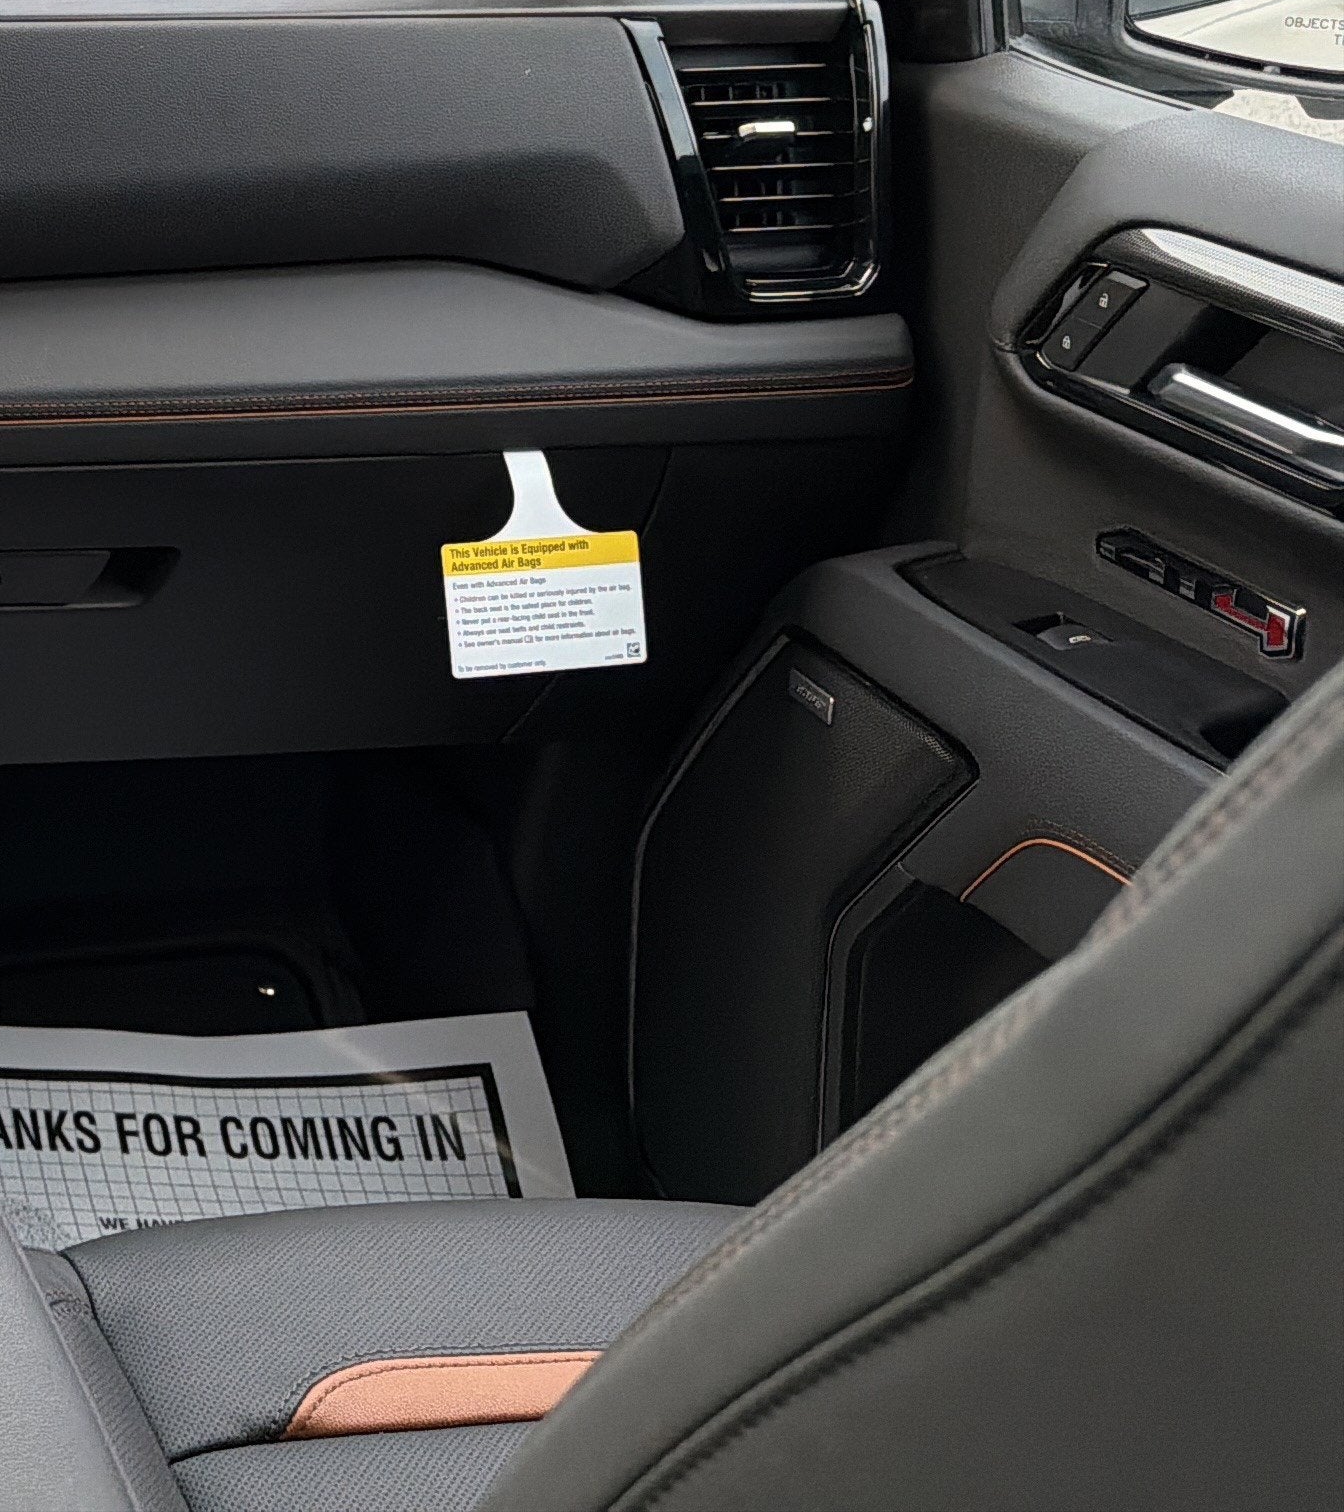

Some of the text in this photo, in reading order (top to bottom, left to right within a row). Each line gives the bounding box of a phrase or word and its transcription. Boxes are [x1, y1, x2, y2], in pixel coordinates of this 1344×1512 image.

[1284, 16, 1344, 31] OBJECTS
[449, 539, 589, 559] This Vehicle is Equipped with
[451, 556, 542, 572] Advanced Air Bags
[115, 1112, 207, 1158] FOR
[220, 1115, 405, 1162] COMING
[419, 1113, 469, 1162] IN
